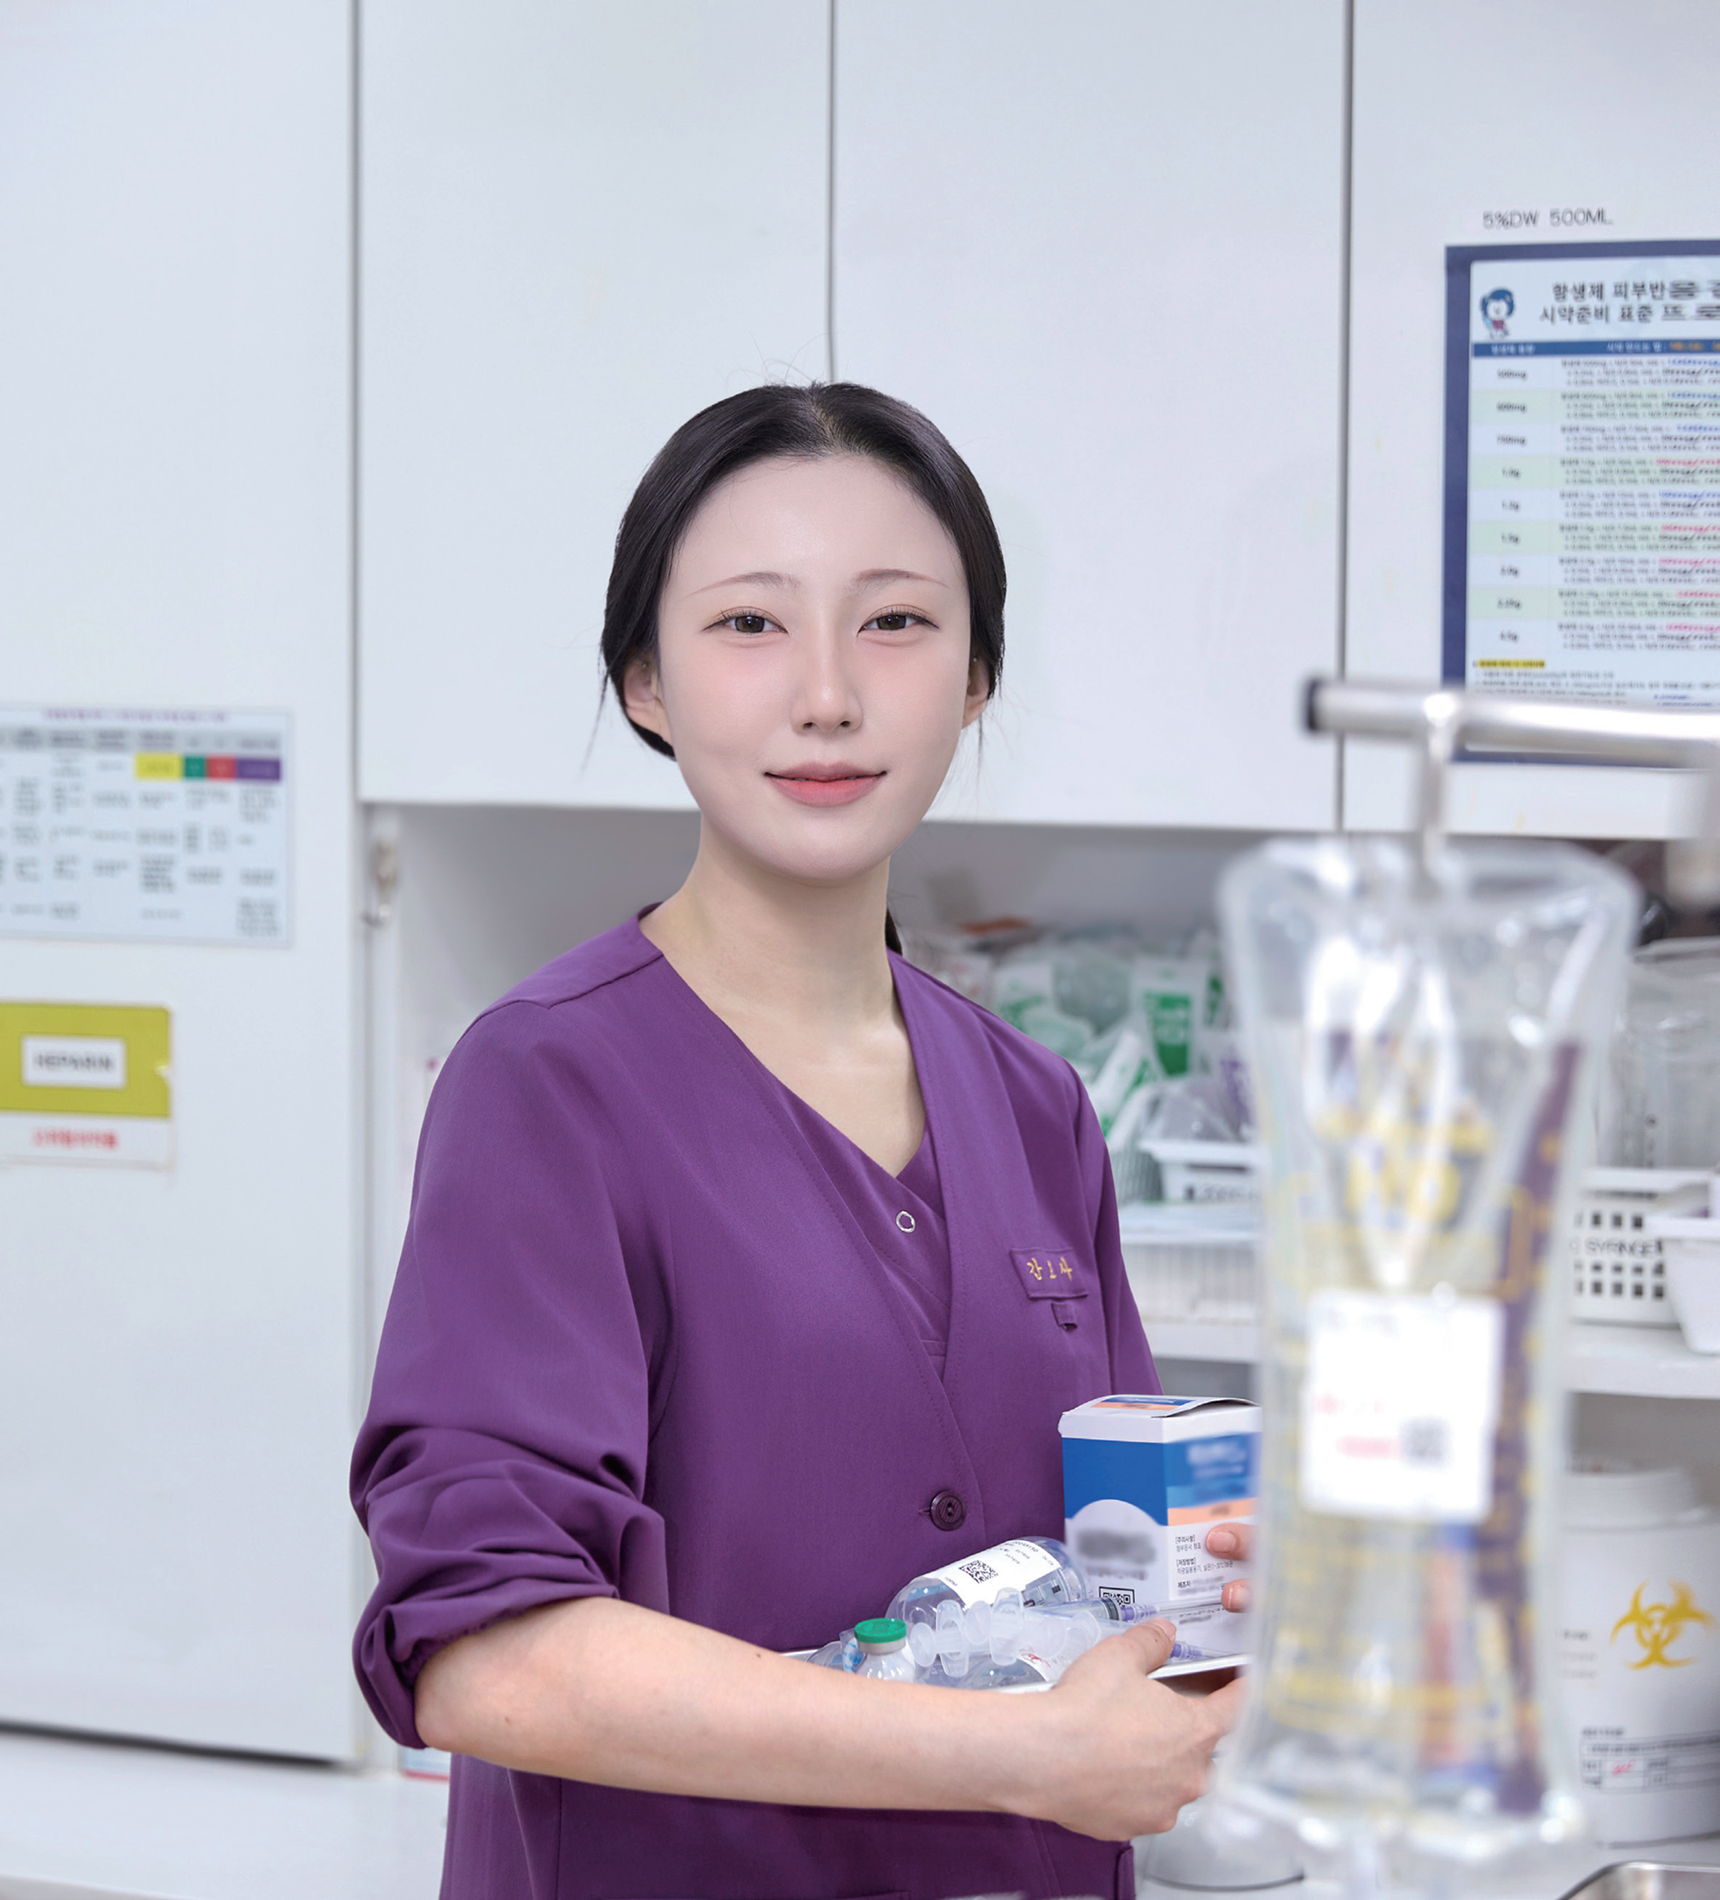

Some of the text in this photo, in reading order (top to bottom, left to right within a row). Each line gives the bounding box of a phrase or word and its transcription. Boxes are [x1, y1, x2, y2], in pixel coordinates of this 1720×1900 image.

[1482, 207, 1614, 229] 5%DW 500ML
[1552, 282, 1604, 302] 항생제
[1612, 279, 1700, 301] 피부반
[1540, 305, 1610, 325] 시약준비
[1618, 304, 1653, 324] 표준
